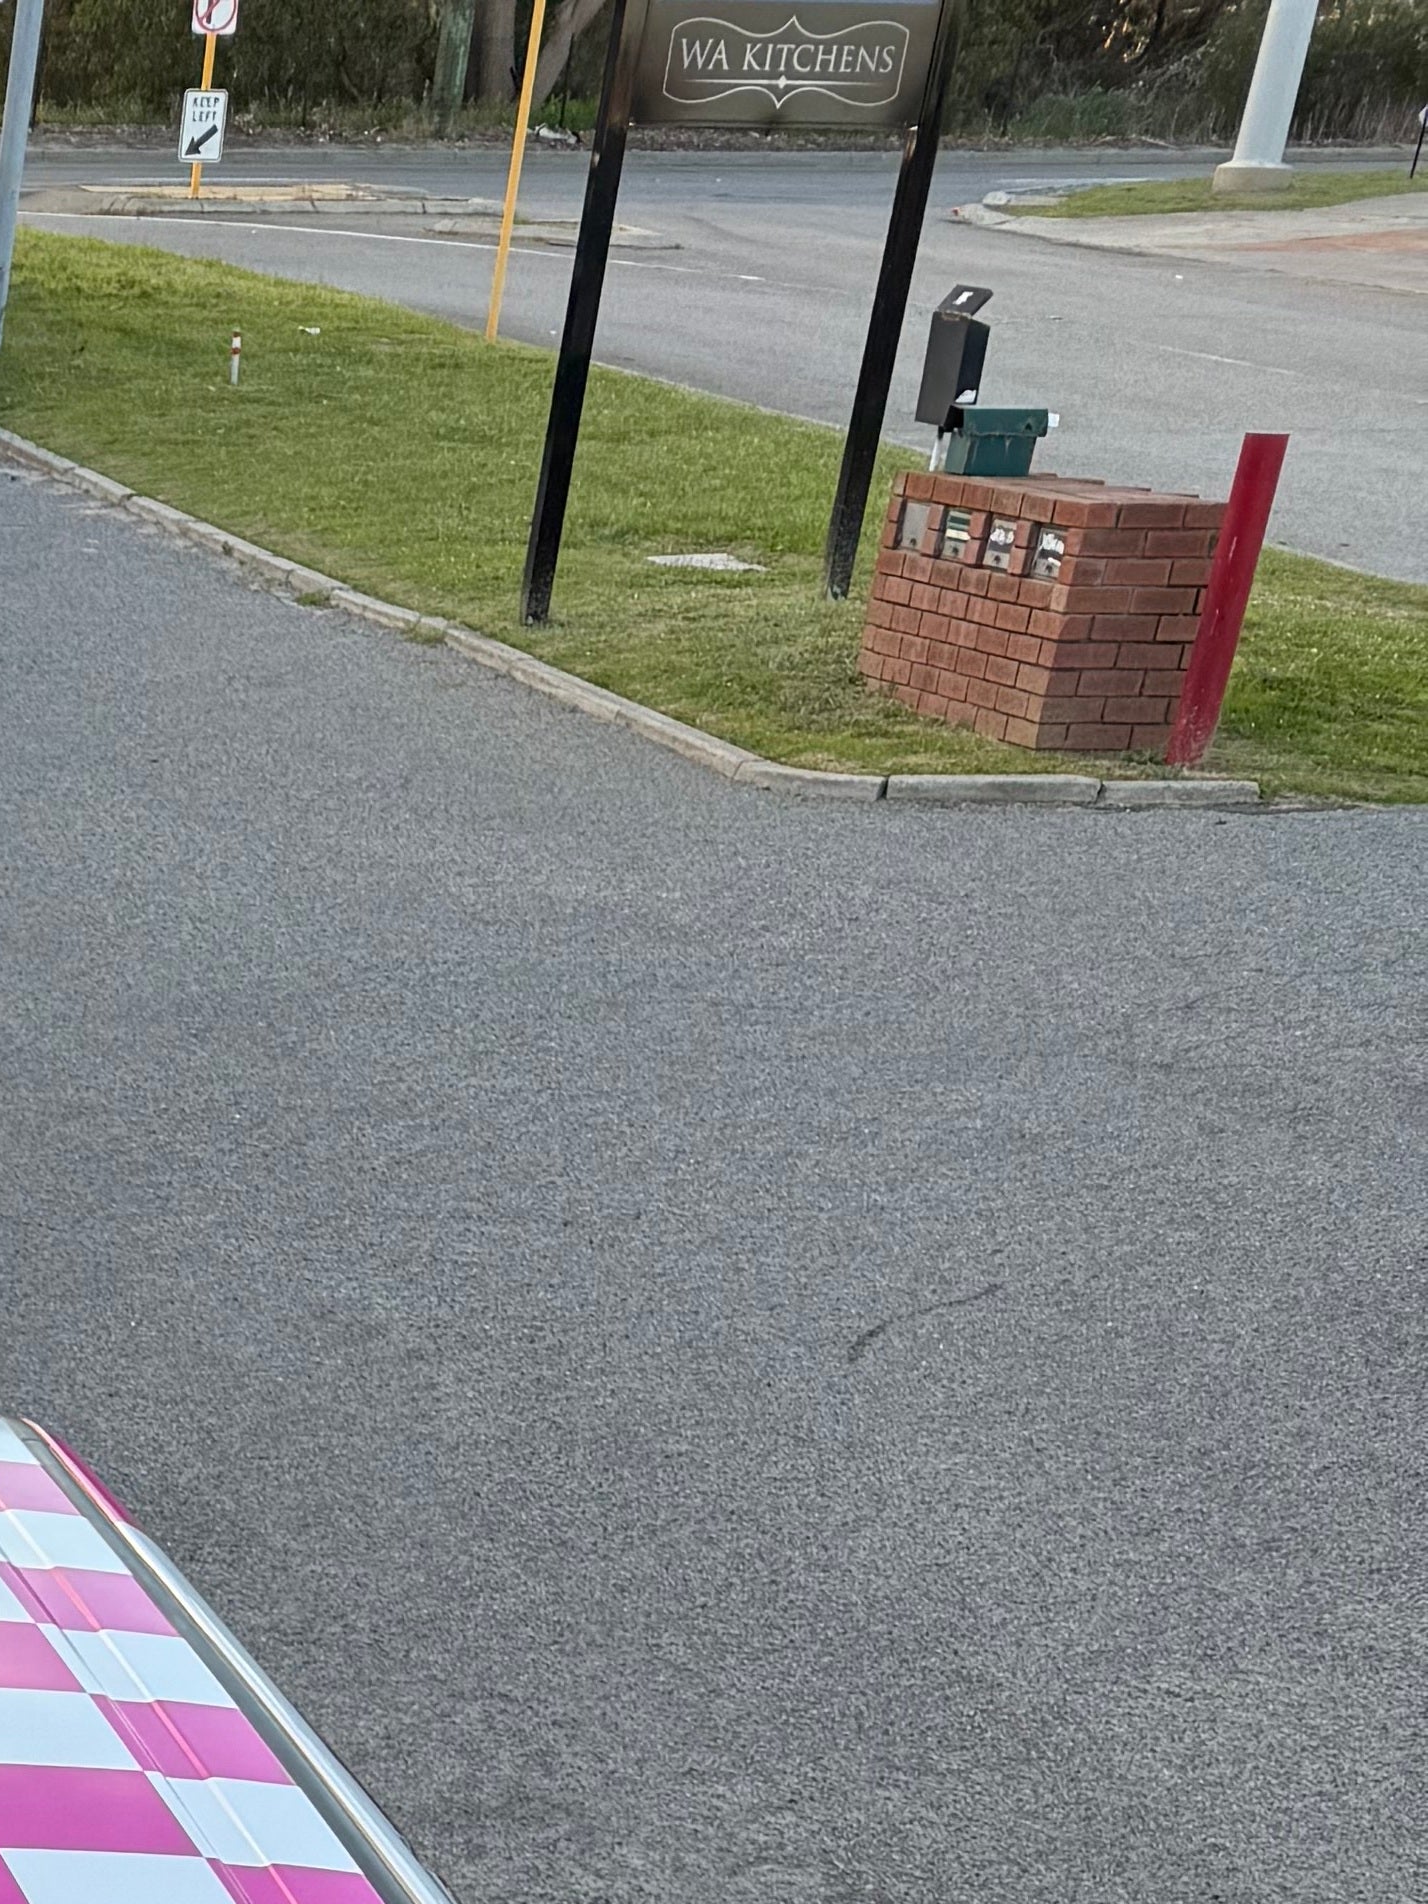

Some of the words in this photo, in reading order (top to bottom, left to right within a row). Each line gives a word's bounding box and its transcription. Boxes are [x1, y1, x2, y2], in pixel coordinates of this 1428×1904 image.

[681, 38, 729, 70] WA
[742, 42, 896, 73] KITCHENS
[193, 97, 220, 108] KEEP
[192, 111, 217, 122] LEFT
